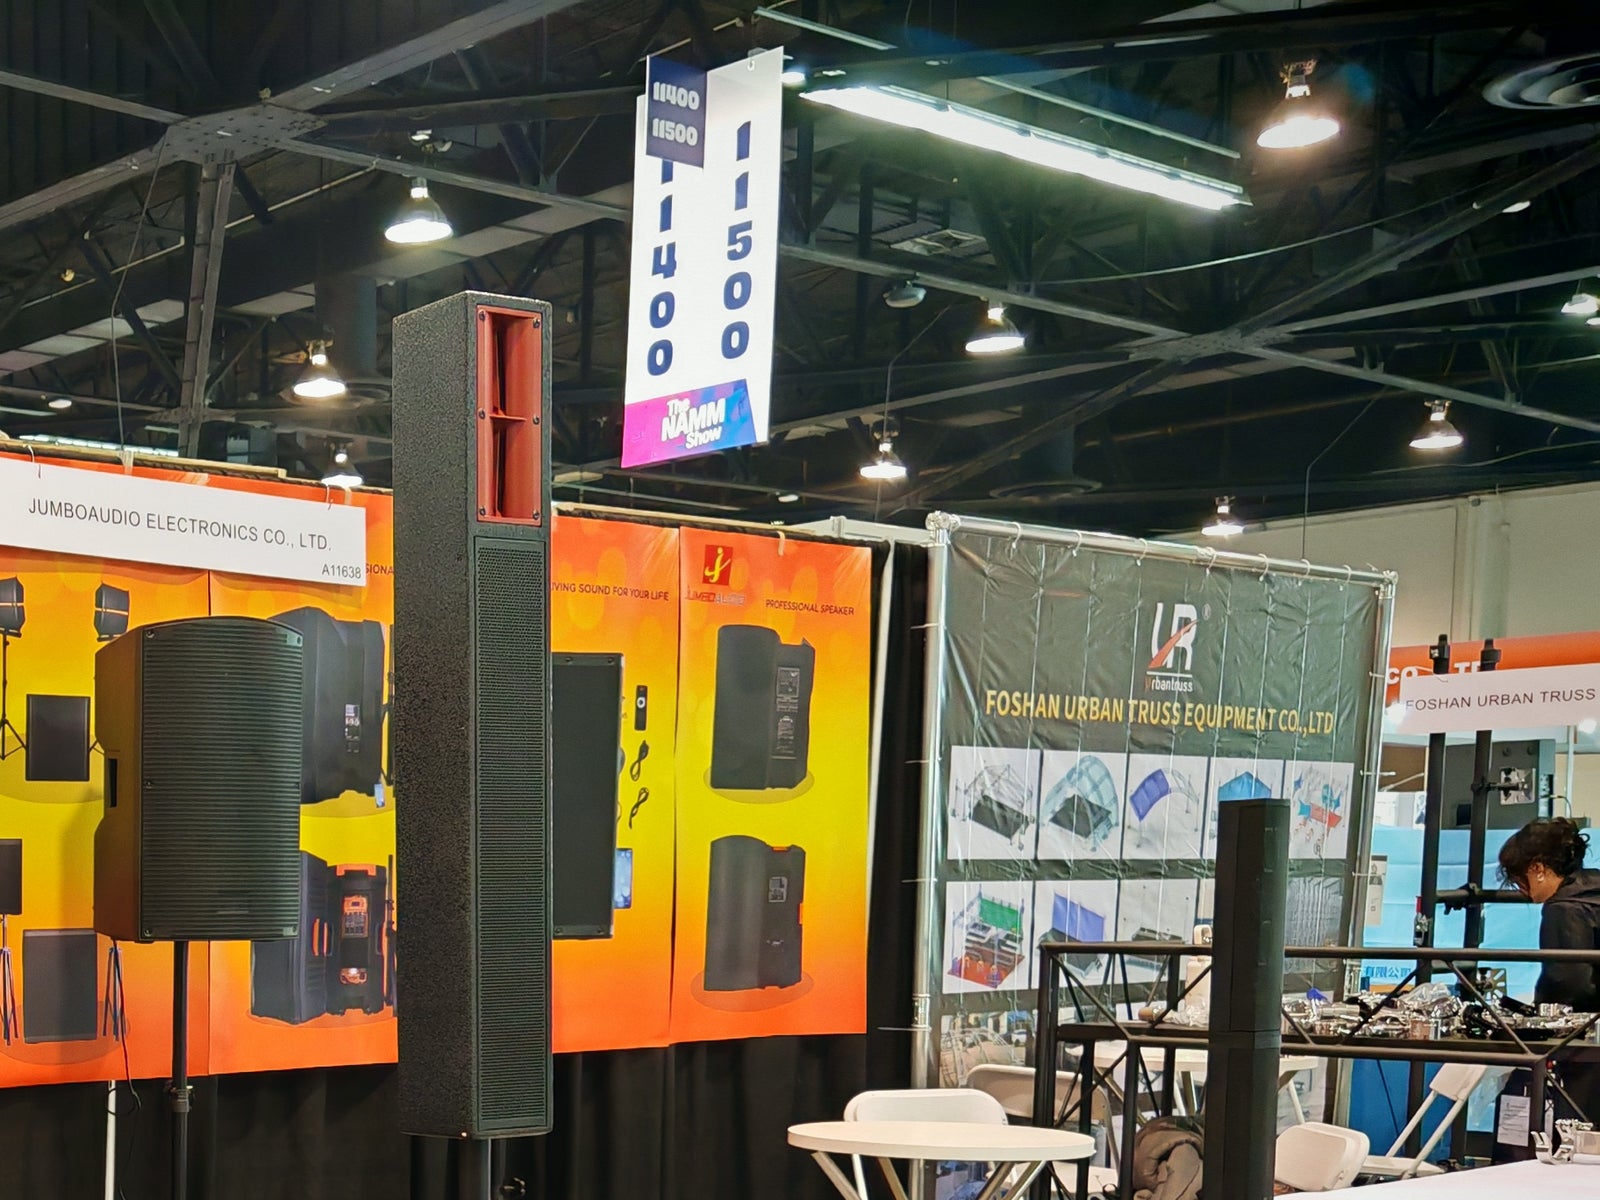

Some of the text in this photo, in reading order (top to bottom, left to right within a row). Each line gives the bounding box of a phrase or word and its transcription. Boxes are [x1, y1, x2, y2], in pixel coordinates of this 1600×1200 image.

[653, 81, 700, 110] 11400
[652, 118, 698, 146] 11500
[721, 121, 753, 359] 11500
[662, 398, 726, 442] NAMM
[667, 398, 690, 417] The
[685, 426, 722, 449] Show
[28, 498, 332, 551] JUMBOAUDIO ELECTRONICS CO., LTD.
[321, 563, 362, 579] A11638
[578, 583, 610, 596] SOUND
[612, 586, 628, 597] FOR
[630, 588, 650, 599] YOUR
[650, 590, 670, 601] LIFE
[766, 599, 855, 616] PROFESSIONAL SPEAKER
[985, 689, 1060, 719] FOSHAN
[1063, 694, 1124, 723] URBAN
[1127, 699, 1181, 727] TRUSS
[1183, 702, 1277, 733] EQUIPMENT
[1405, 688, 1596, 712] FOSHAN URBAN TRUSS
